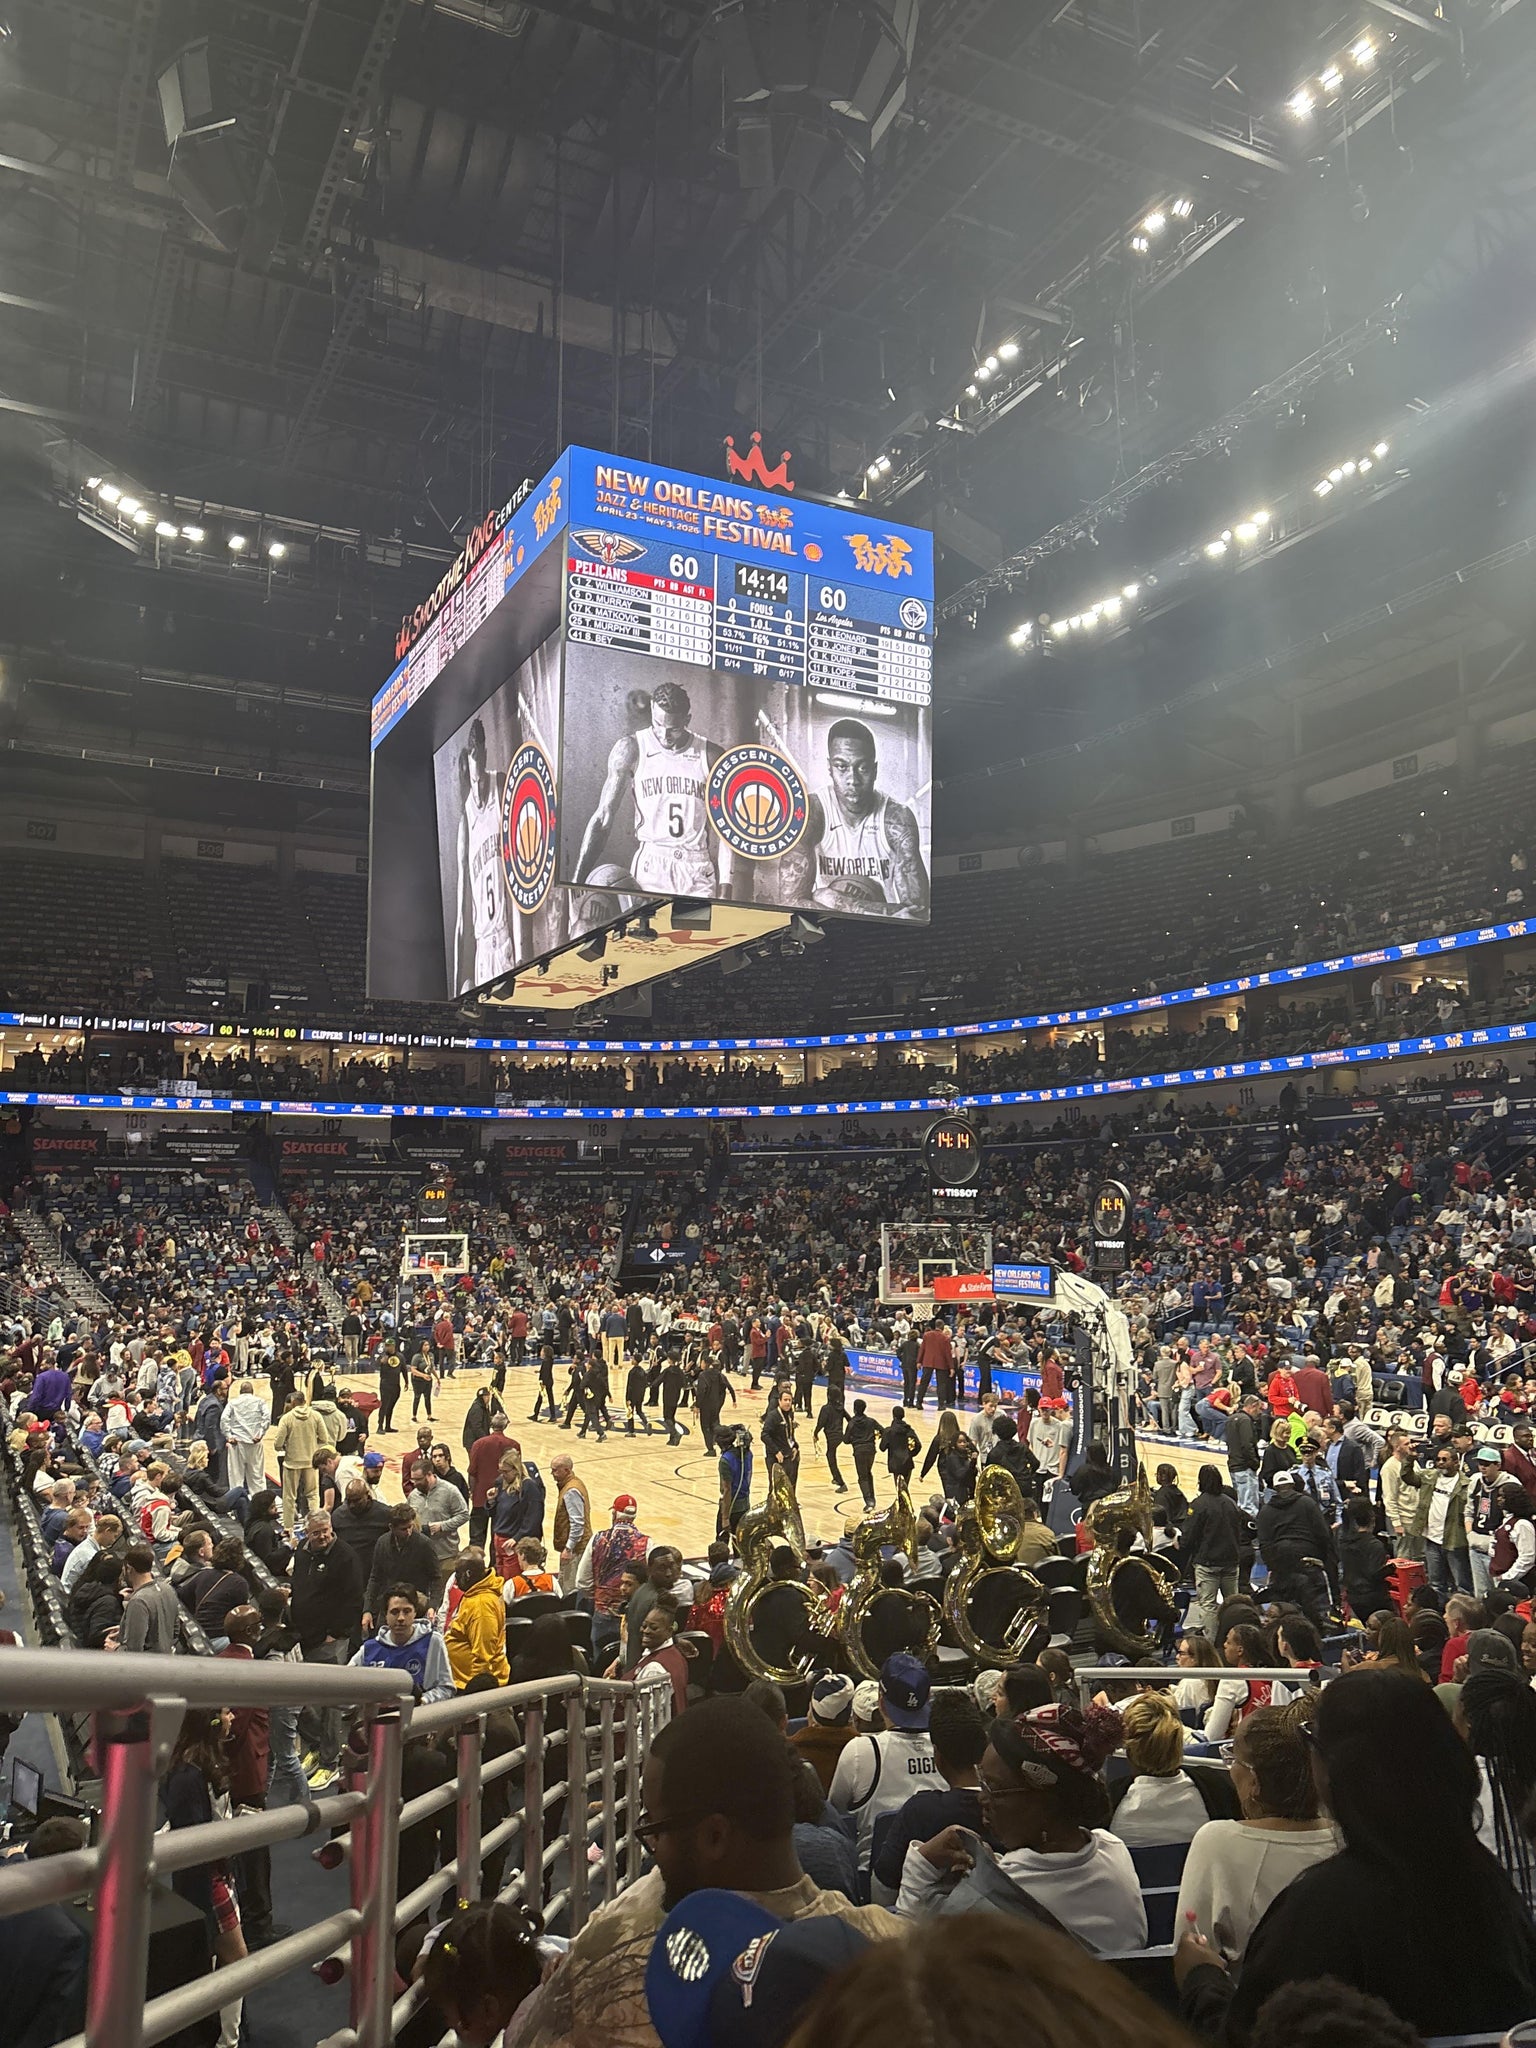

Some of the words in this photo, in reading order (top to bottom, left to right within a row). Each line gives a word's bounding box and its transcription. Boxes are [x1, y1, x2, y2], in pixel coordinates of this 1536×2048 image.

[595, 465, 650, 496] NEW
[654, 480, 753, 521] ORLEANS
[596, 490, 626, 508] JAZZ
[629, 498, 642, 510] &
[643, 500, 699, 524] HERITAGE
[595, 505, 626, 518] APRIL
[625, 511, 638, 521] 23
[645, 516, 665, 528] MAY
[676, 523, 700, 535] 2026
[703, 515, 798, 556] FESTIVAL
[411, 551, 465, 640] SMOOTHIE
[464, 510, 498, 572] KING
[495, 479, 531, 530] CENTER
[669, 553, 699, 581] 60
[575, 560, 628, 582] PELICANS
[654, 578, 666, 588] PTS
[683, 584, 695, 594] AST
[699, 588, 706, 597] FL
[738, 567, 788, 595] 14:14
[585, 579, 593, 588] Z.
[595, 581, 649, 599] WILLIAMSON
[656, 594, 664, 602] 10
[585, 593, 593, 601] D.
[596, 594, 633, 609] MURRAY
[820, 586, 847, 612] 60
[595, 608, 639, 624] MATKOVIC
[729, 598, 736, 609] 0
[750, 602, 774, 616] FOULS
[785, 610, 793, 620] 0
[594, 620, 633, 636] MURPHY
[655, 633, 662, 641] 14
[728, 613, 736, 624] 4
[750, 618, 772, 631] T.O.L.
[785, 625, 792, 635] 6
[815, 611, 828, 622] Los
[828, 615, 853, 627] Angeles
[905, 632, 916, 640] AST
[595, 635, 613, 644] BEY
[753, 634, 769, 646] FG%
[832, 630, 867, 644] LEONARD
[724, 643, 742, 653] 11/11
[756, 649, 765, 660] FT
[832, 643, 856, 653] JONES
[831, 655, 852, 665] DUNN
[753, 664, 768, 675] 3PT
[831, 667, 856, 678] LOPEZ
[830, 679, 856, 690] MILLER
[536, 756, 553, 796] CITY
[712, 750, 777, 789] CRESCENT
[781, 765, 803, 800] CITY
[641, 778, 663, 798] NEW
[669, 803, 684, 838] 5
[716, 819, 798, 854] BASKETBALL
[819, 856, 846, 876] NEW
[508, 845, 555, 905] BASKETBALL
[485, 871, 495, 920] 5
[220, 1026, 233, 1035] 60
[252, 1028, 275, 1036] 14:14
[284, 1028, 296, 1038] 60
[311, 1031, 343, 1040] CLIPPERS
[125, 1114, 147, 1128] 106
[321, 1119, 342, 1133] 107
[588, 1124, 607, 1137] 108
[33, 1138, 98, 1151] SEATGEEK
[938, 1132, 970, 1149] 14:14
[282, 1141, 348, 1155] SEATGEEK
[506, 1145, 566, 1158] SEATGEEK
[945, 1188, 978, 1197] TISSOT
[1101, 1197, 1123, 1211] 14:14
[995, 1269, 1007, 1278] NEW
[1007, 1269, 1031, 1279] ORLEANS
[1018, 1280, 1042, 1290] FESTIVAL
[858, 1355, 869, 1364] NEW
[869, 1356, 886, 1367] ORLEANS
[875, 1366, 894, 1376] FESTIVAL
[1022, 1377, 1033, 1386] NEW
[1371, 1410, 1382, 1422] G
[1391, 1413, 1401, 1425] G
[1415, 1416, 1427, 1429] G
[1494, 1427, 1506, 1439] G
[1478, 1515, 1487, 1528] 2
[907, 1693, 918, 1707] LA
